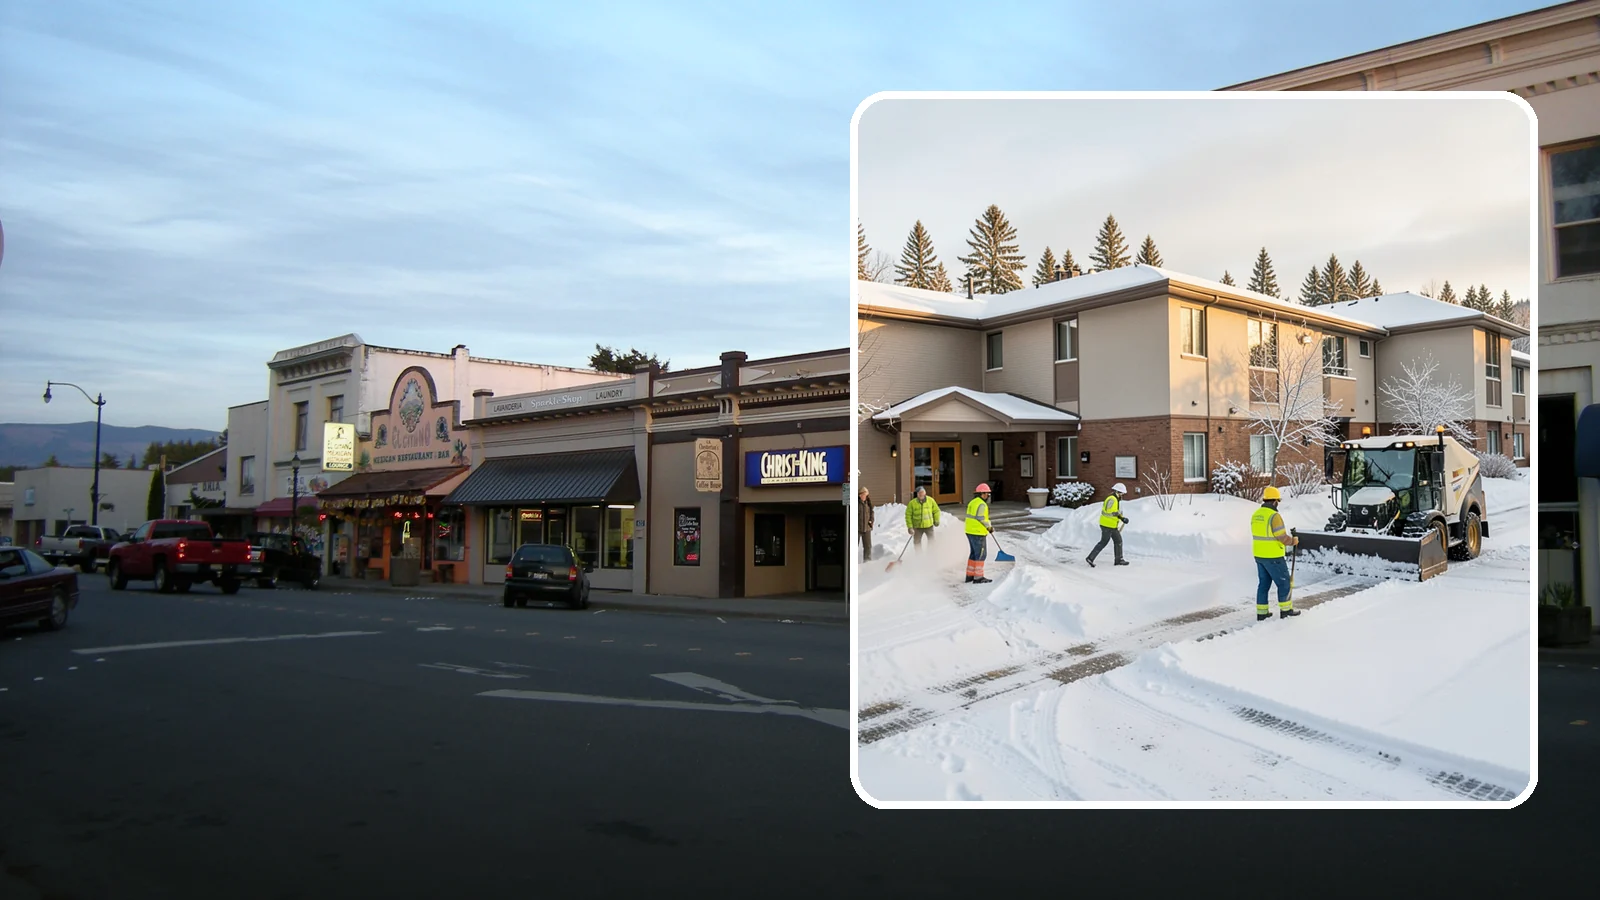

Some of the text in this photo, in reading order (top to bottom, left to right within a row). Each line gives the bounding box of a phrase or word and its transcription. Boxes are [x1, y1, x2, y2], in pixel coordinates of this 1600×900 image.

[494, 389, 624, 413] LAVANDERIA Sparkle Shop LAUNDRY
[373, 455, 396, 464] MEXICAN
[397, 451, 433, 462] RESTAURANT
[437, 450, 450, 459] BAR
[761, 450, 827, 478] CHRIST KING
